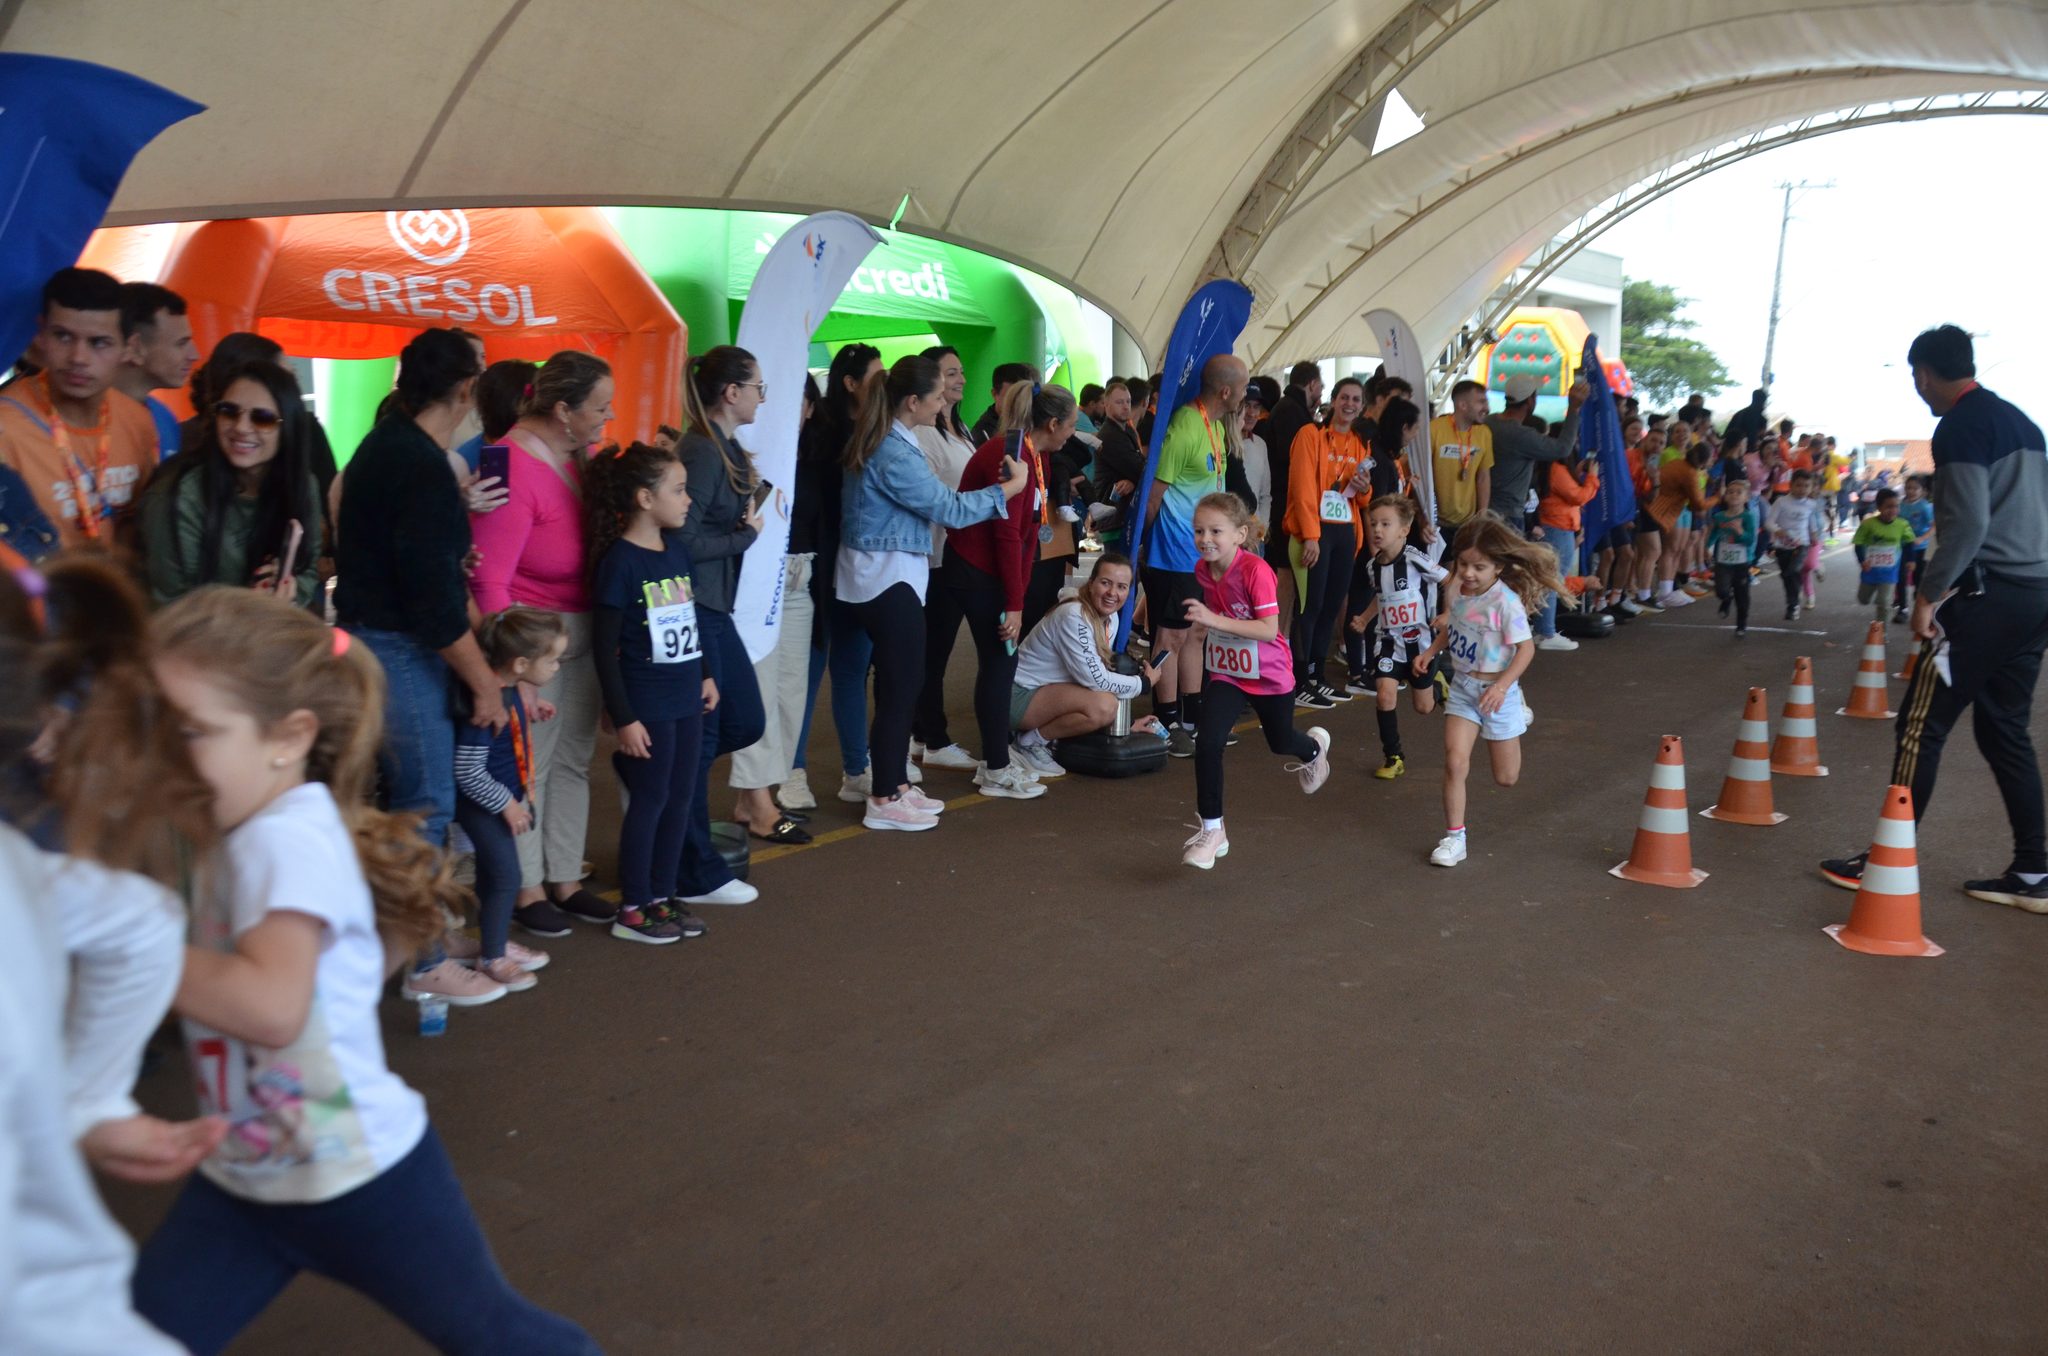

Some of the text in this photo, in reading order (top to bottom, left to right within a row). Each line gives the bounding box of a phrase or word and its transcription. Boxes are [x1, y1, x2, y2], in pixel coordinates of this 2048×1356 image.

[322, 268, 558, 327] CRESOL
[845, 262, 950, 300] credi
[1326, 502, 1348, 519] 261
[1381, 602, 1418, 626] 1367
[664, 622, 700, 658] 92
[1208, 643, 1252, 673] 1280
